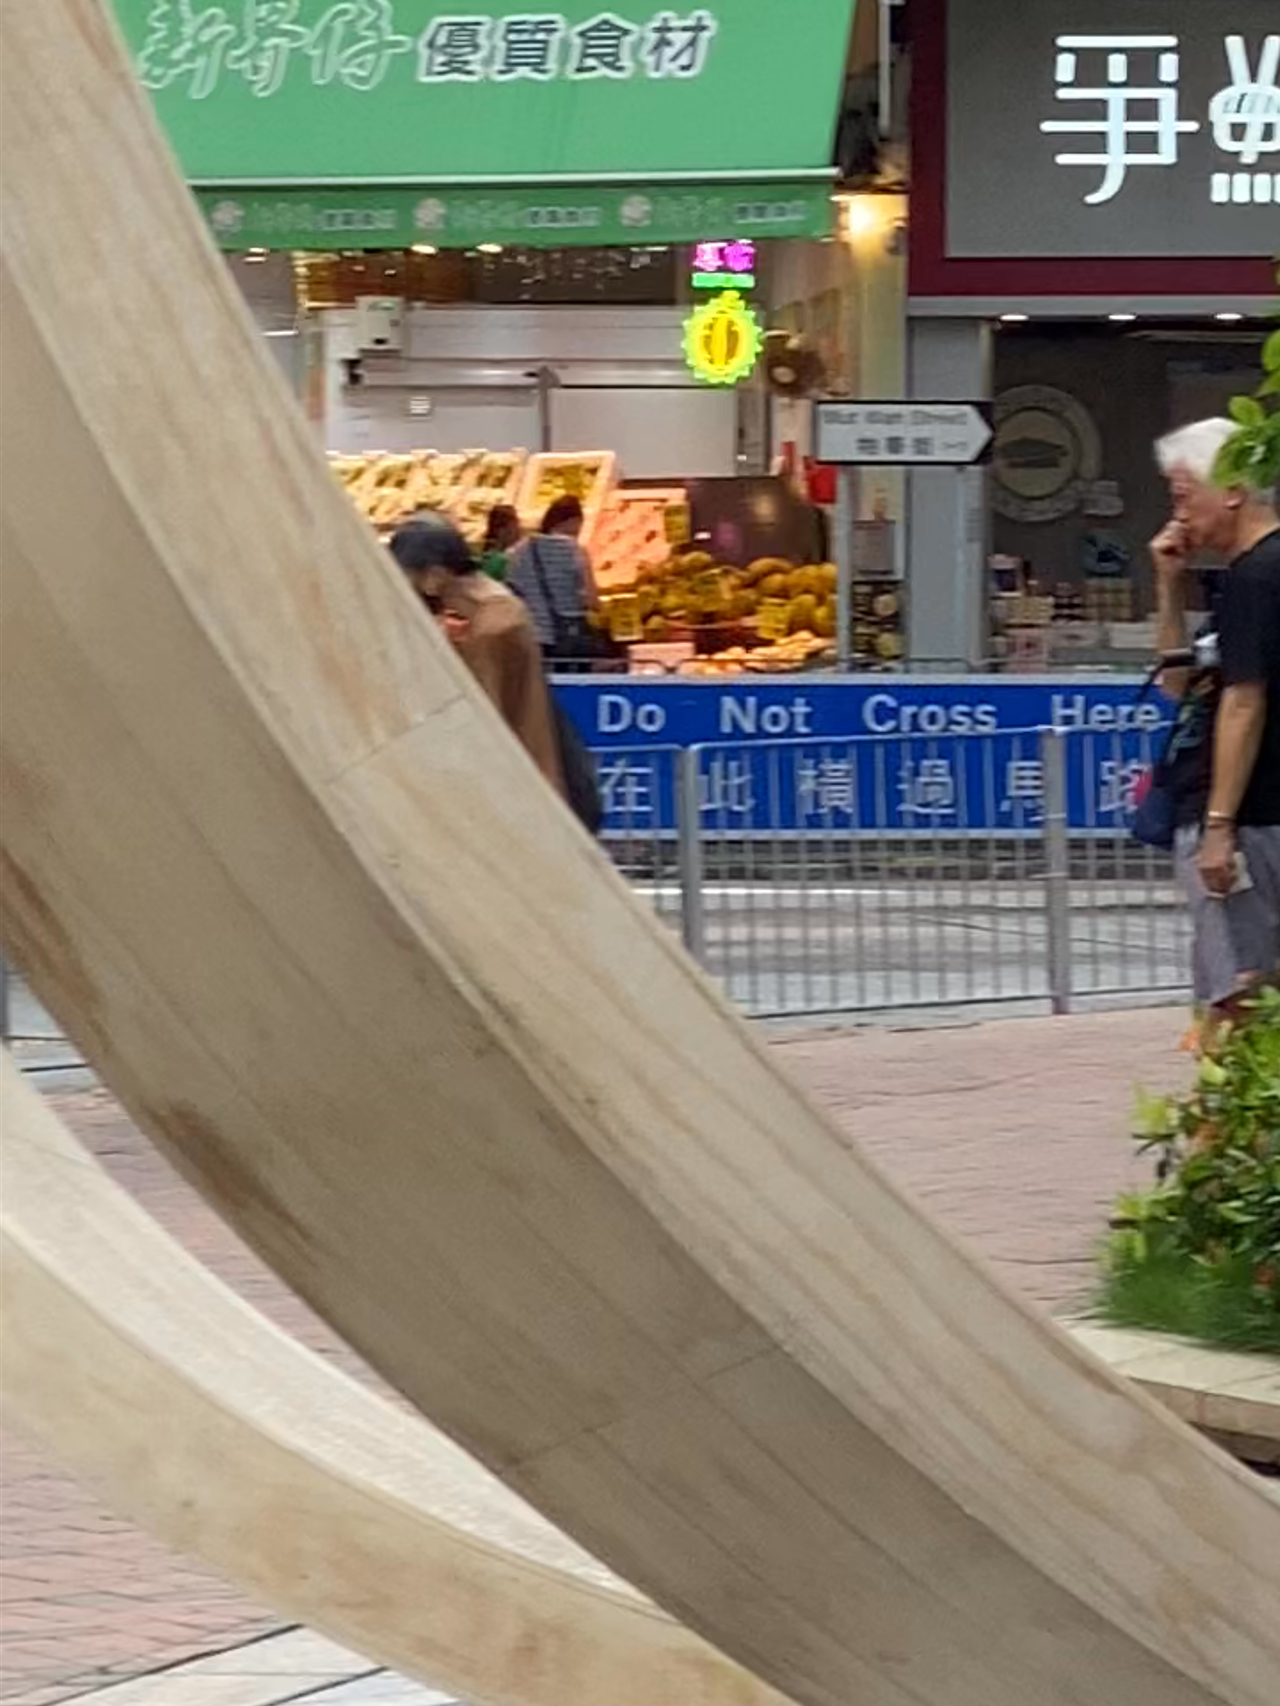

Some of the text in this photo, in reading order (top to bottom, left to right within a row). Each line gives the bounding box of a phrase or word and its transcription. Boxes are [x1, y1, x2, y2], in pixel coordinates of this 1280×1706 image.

[598, 694, 1162, 734] Do Not Cross Here
